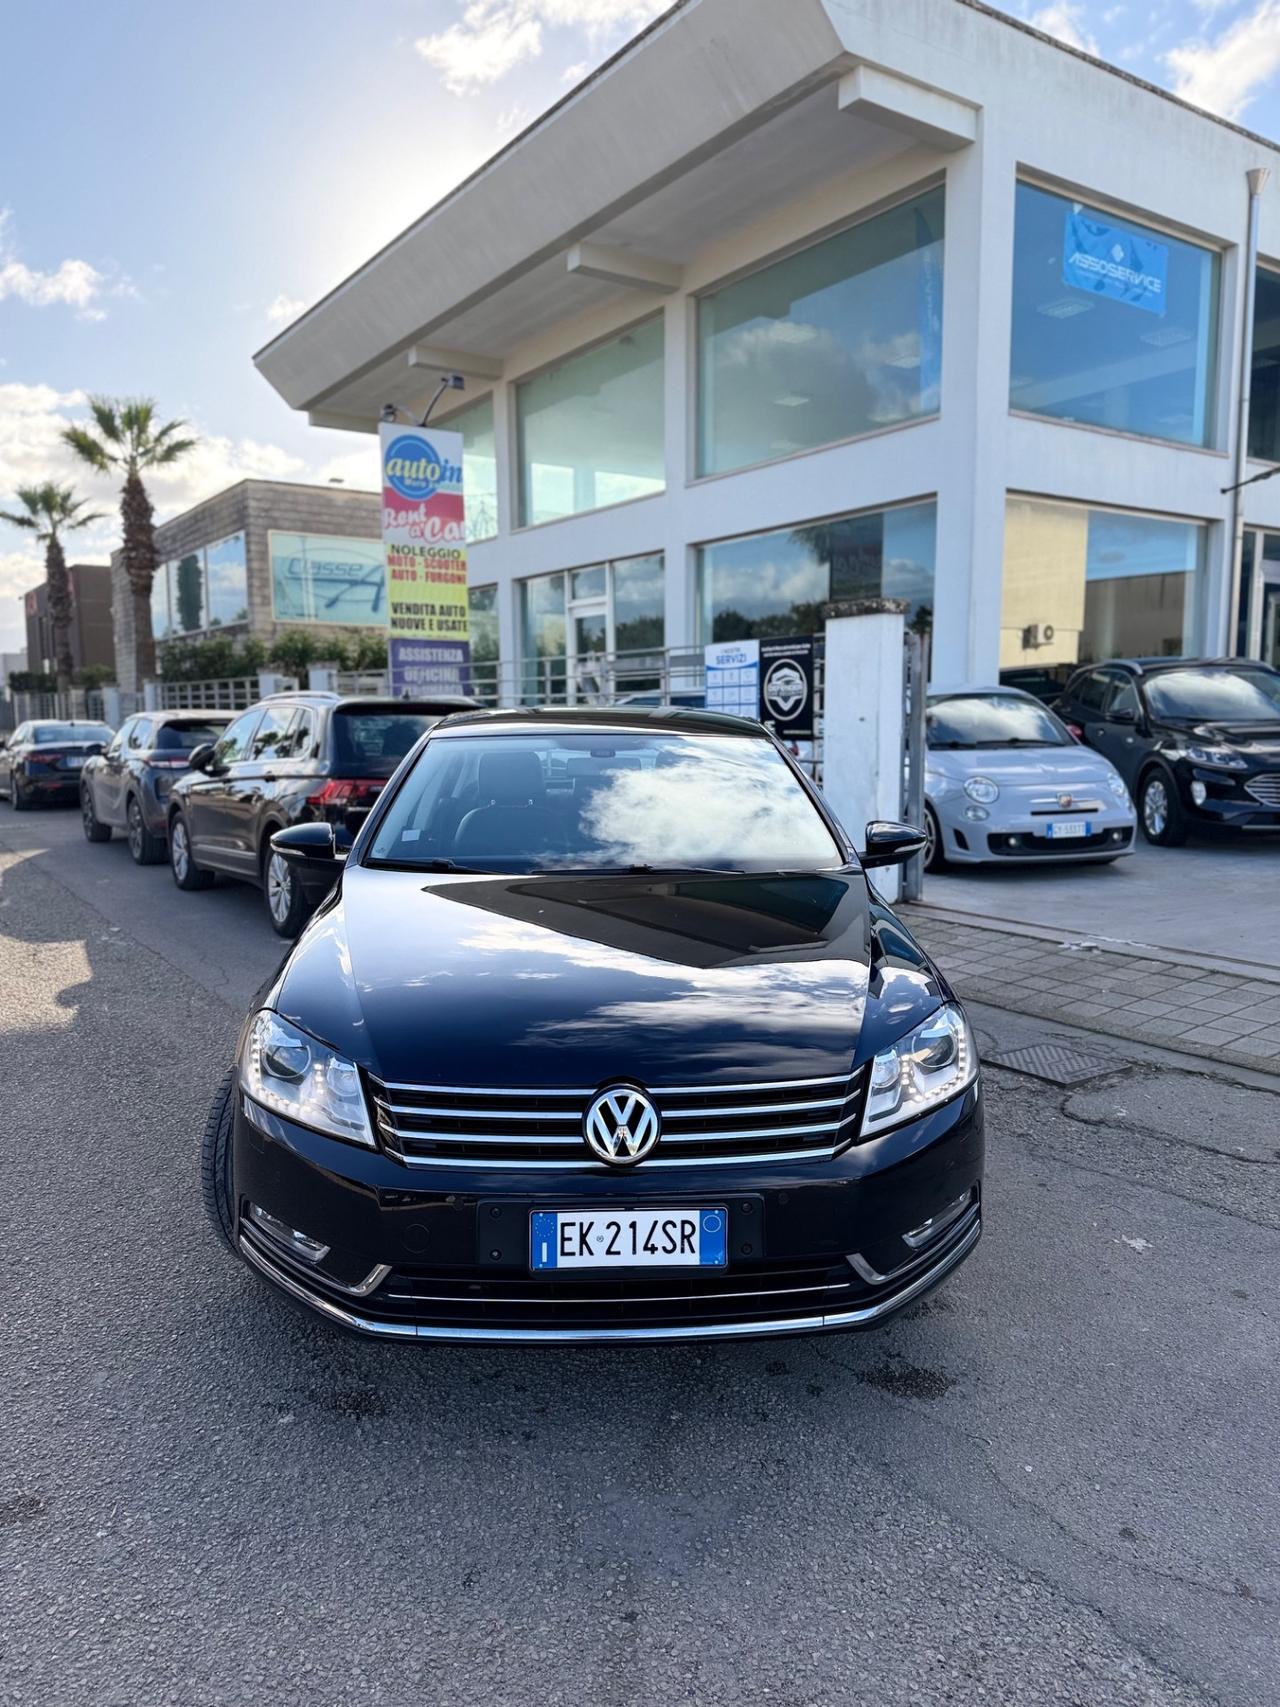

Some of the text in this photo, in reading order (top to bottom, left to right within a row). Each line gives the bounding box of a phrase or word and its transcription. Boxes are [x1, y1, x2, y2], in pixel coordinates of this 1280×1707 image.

[1069, 252, 1161, 293] ASSOSERVICE
[384, 503, 426, 529] Rent
[391, 544, 461, 559] NOLEGGIO
[387, 555, 416, 568] MOTO
[424, 557, 466, 573] SCOOTER
[391, 569, 417, 582] AUTO
[425, 571, 466, 585] FURGONI
[391, 601, 466, 618] VENDITA AUTO
[391, 617, 468, 633] NUOVE E USATE
[398, 647, 464, 663] ASSISTENZA
[716, 653, 747, 665] SERVIZI
